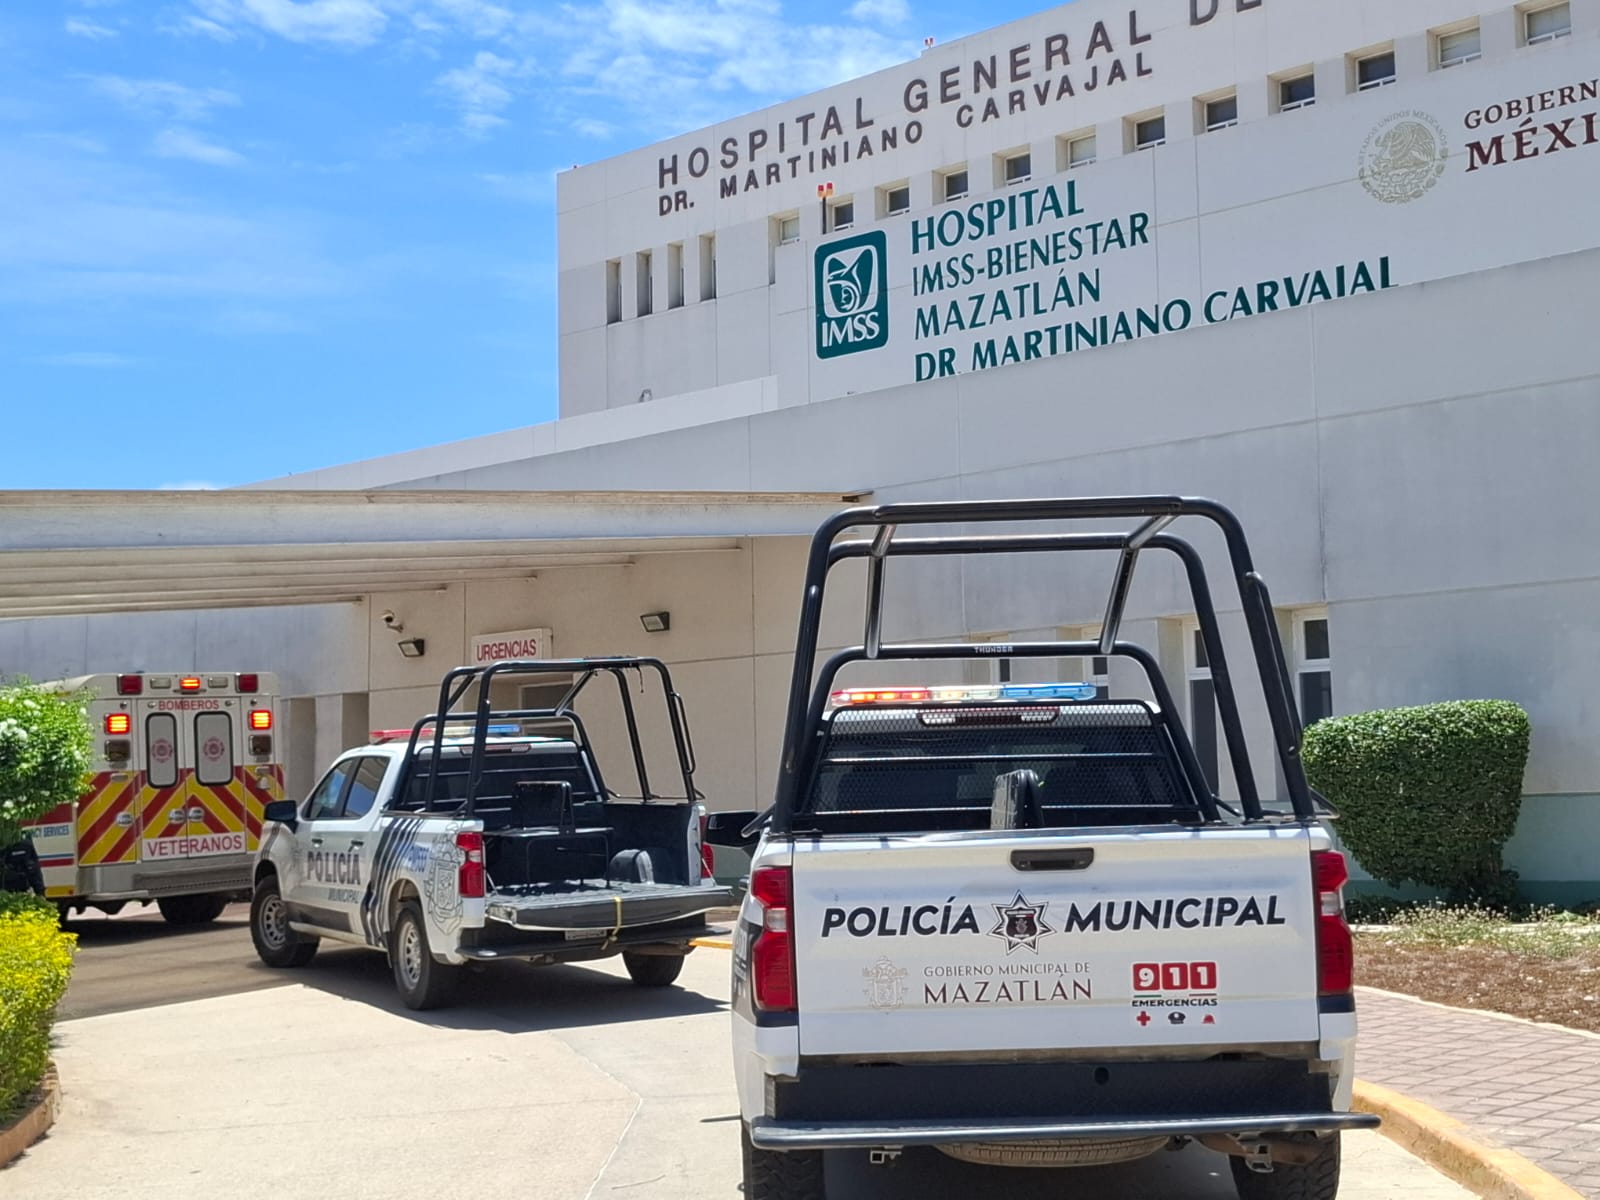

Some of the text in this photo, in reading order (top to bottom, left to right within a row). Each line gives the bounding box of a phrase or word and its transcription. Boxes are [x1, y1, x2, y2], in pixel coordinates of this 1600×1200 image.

[659, 97, 874, 189] HOSPITAL
[903, 10, 1152, 113] GENERAL
[659, 52, 1153, 216] DR. MARTINIANO CARVAJAL
[912, 179, 1084, 254] HOSPITAL
[912, 211, 1149, 296] IMSS-BIENESTAR
[915, 268, 1100, 340] MAZATLÁN
[821, 310, 880, 348] IMSS
[972, 298, 1192, 371] MARTINIANO
[477, 638, 537, 661] URGENCIAS
[974, 646, 1013, 654] THUNDER
[158, 700, 220, 711] BOMBEROS
[147, 835, 242, 857] VETERANOS
[306, 845, 361, 886] POLICÍA
[821, 895, 1286, 938] POLICÍA MUNICIPAL
[924, 962, 1090, 977] GOBIERNO MUNICIPAL DE
[924, 972, 1092, 1004] MAZATLÁN
[1138, 966, 1209, 988] 911
[1131, 998, 1218, 1007] EMERGENCIAS
